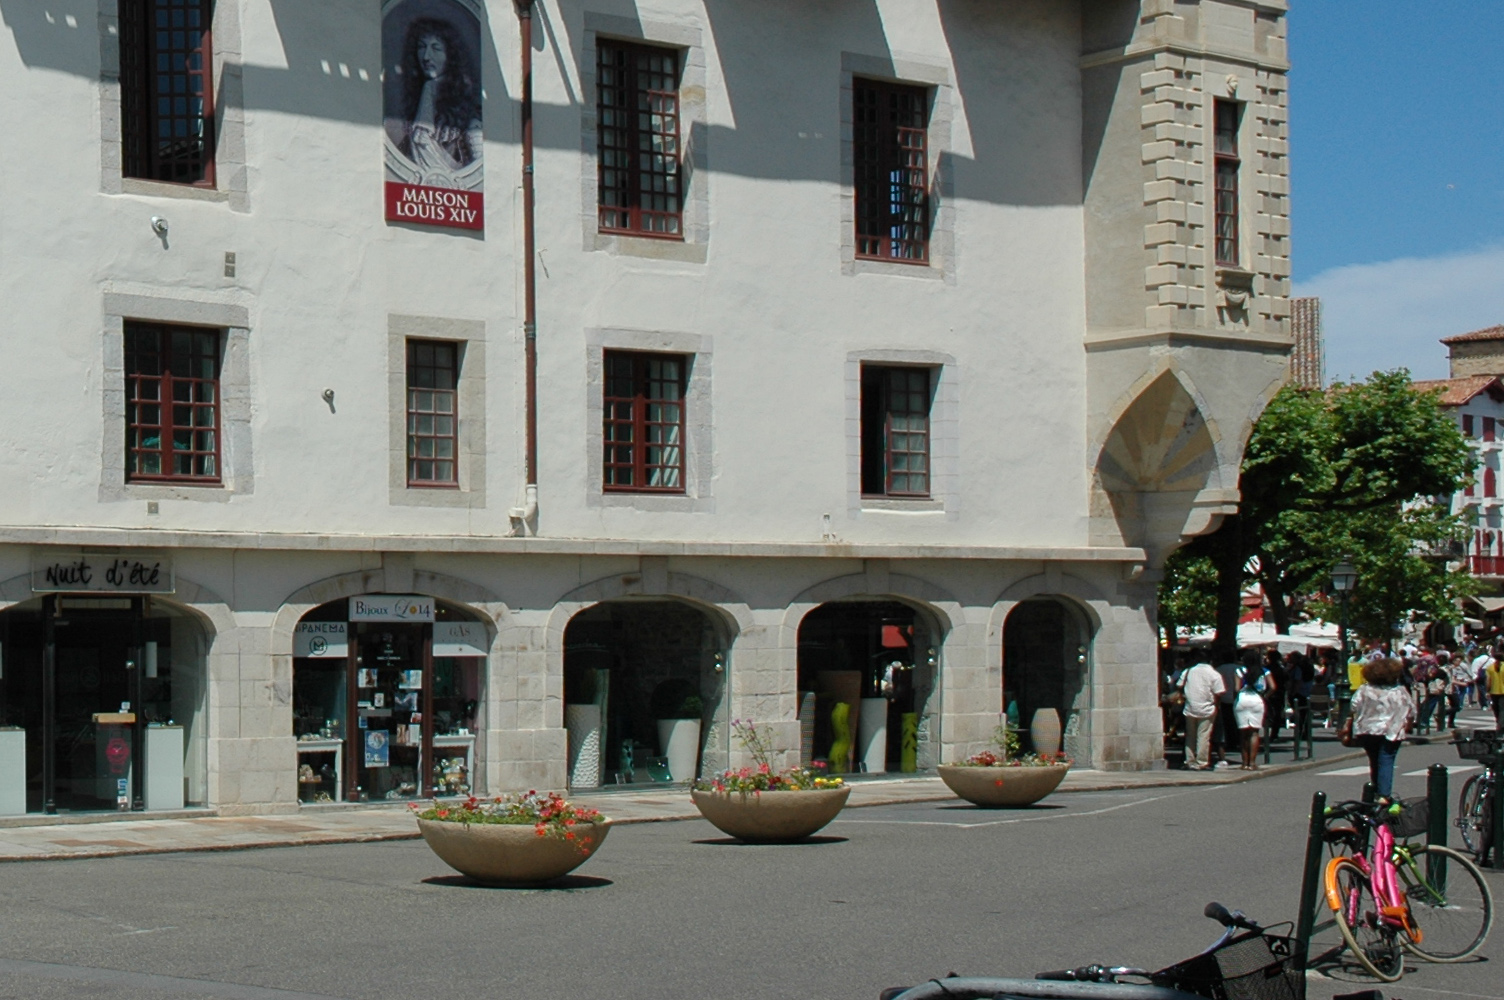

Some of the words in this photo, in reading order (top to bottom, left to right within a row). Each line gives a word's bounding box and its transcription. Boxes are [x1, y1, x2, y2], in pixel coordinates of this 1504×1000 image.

[402, 188, 469, 208] MAISON
[396, 201, 445, 220] LOUIS
[449, 207, 477, 223] XIV
[46, 558, 93, 586] Nuit
[105, 559, 161, 586] d'été
[355, 600, 389, 616] Bijoux
